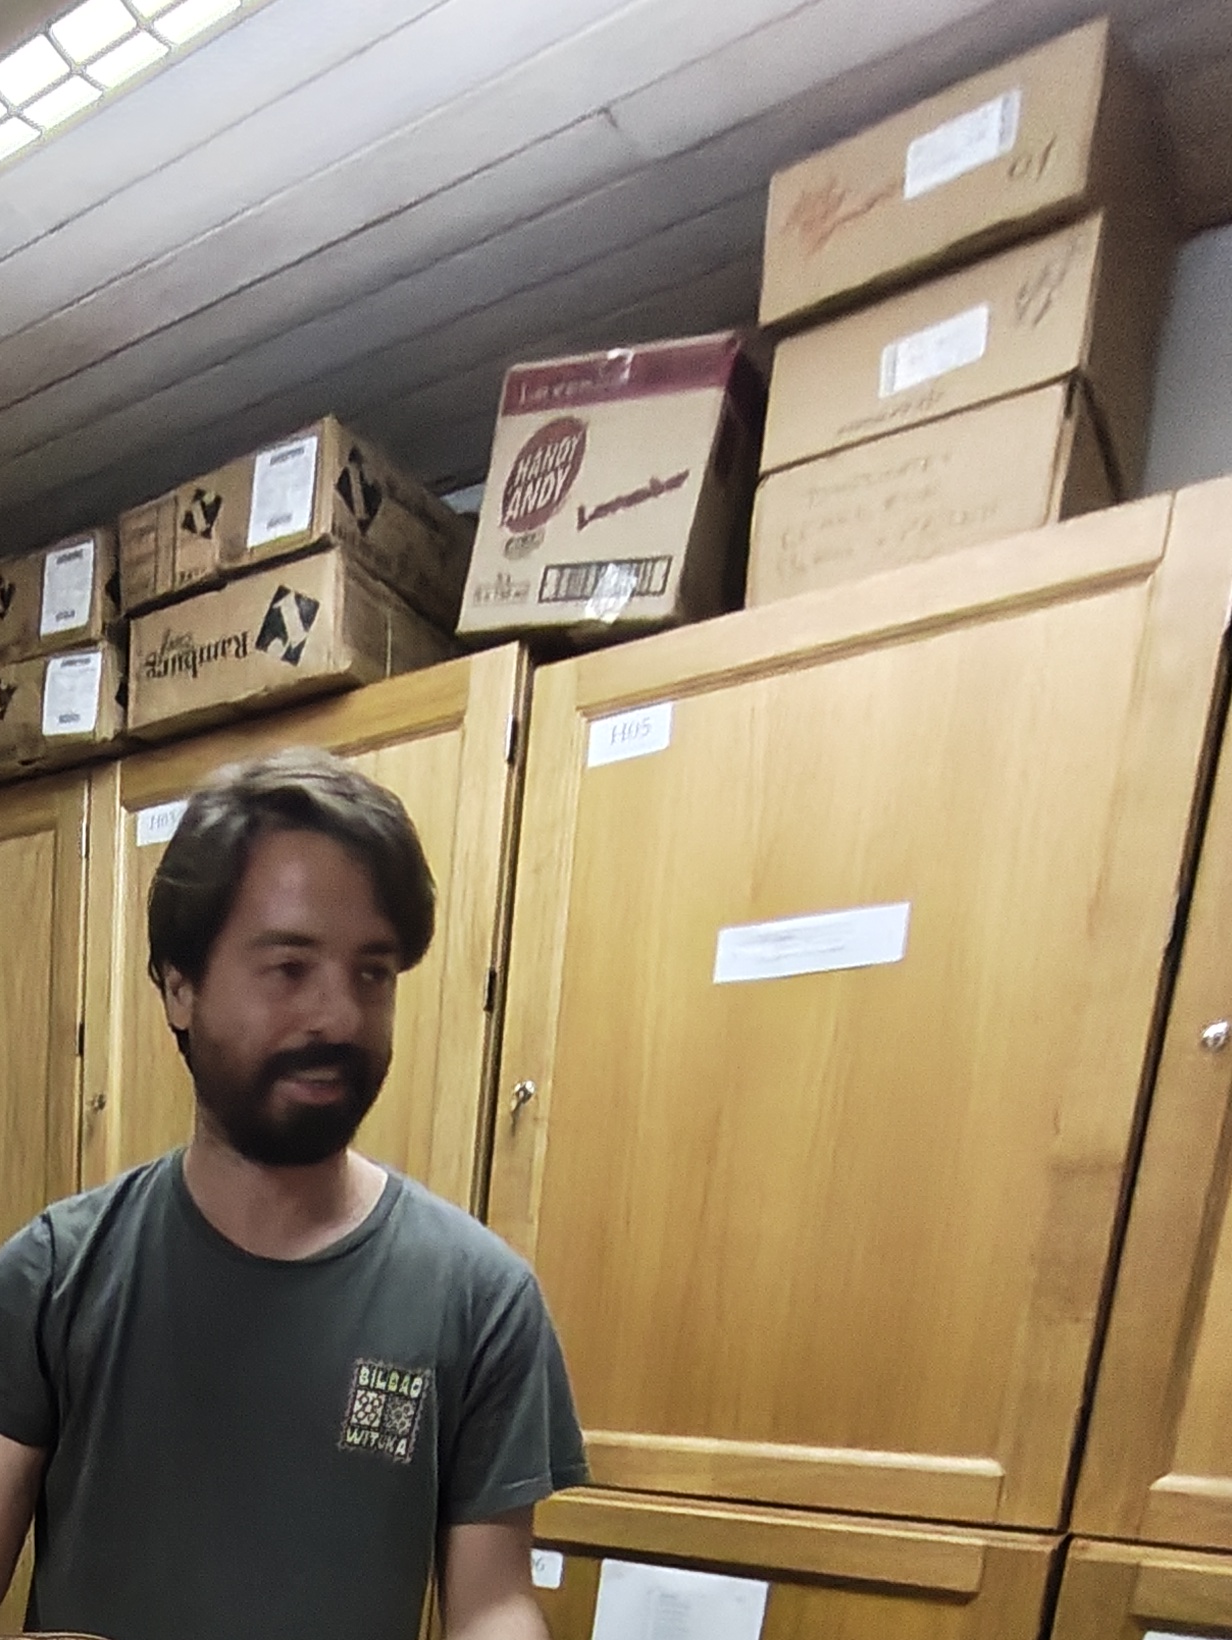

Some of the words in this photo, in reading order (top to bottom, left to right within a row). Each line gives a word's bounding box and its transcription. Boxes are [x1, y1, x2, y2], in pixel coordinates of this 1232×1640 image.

[513, 432, 584, 487] HANDY
[503, 463, 572, 522] ANDY
[610, 716, 652, 746] H05
[358, 1366, 424, 1399] BILBAO
